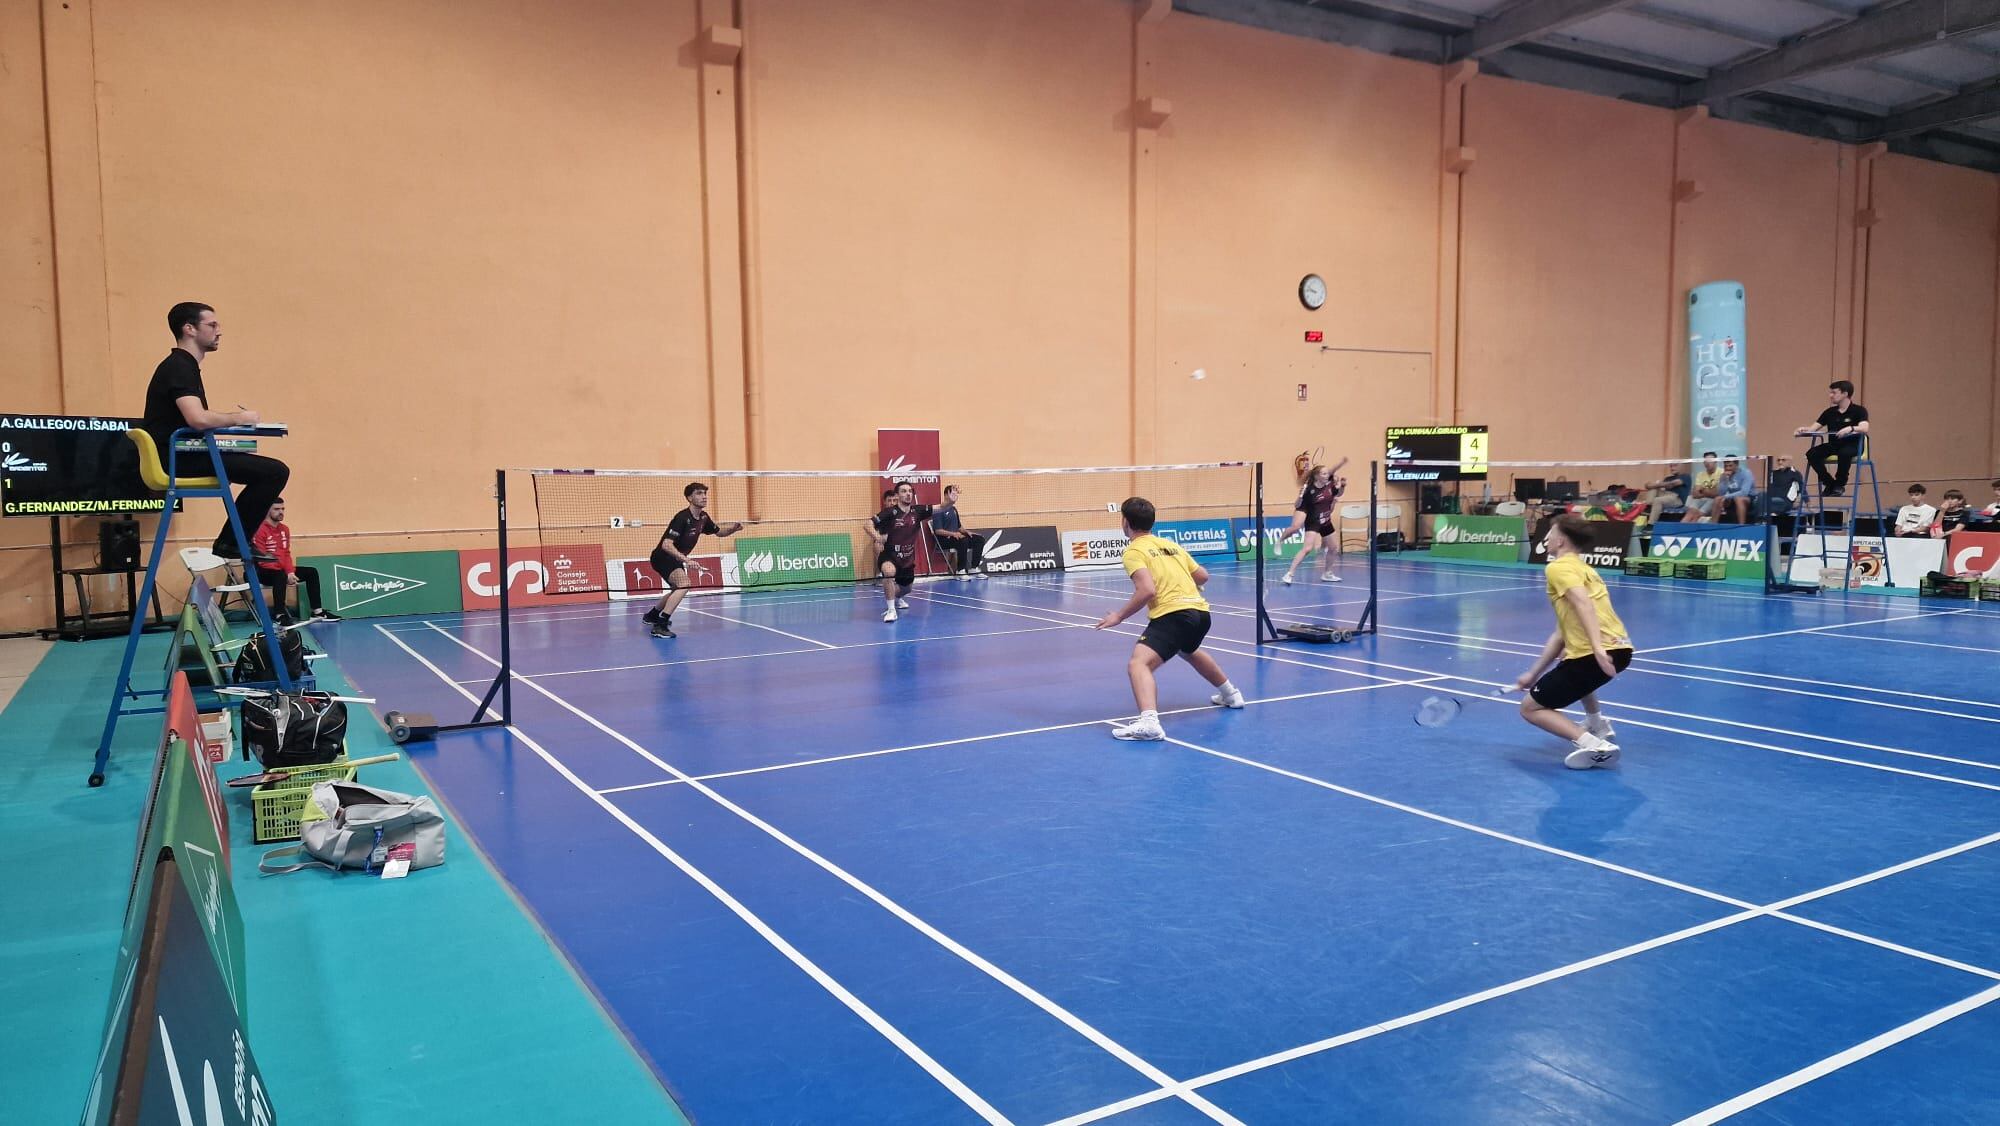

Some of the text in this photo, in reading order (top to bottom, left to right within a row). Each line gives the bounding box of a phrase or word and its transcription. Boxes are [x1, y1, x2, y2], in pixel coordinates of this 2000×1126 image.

[2, 442, 11, 453] 0
[1470, 438, 1479, 450] 4
[1470, 457, 1478, 469] 7
[5, 479, 12, 488] 1
[5, 499, 179, 513] G.FERNANDEZ/M.FERNANDZ
[613, 518, 620, 528] 2
[1178, 530, 1227, 541] LOTERÍAS
[1460, 528, 1516, 546] Iberdrola
[1090, 551, 1102, 559] DE
[1695, 537, 1764, 561] YONEX
[777, 552, 849, 571] Iberdrola
[986, 559, 1057, 572] BADMINTON
[557, 571, 586, 579] Consejo
